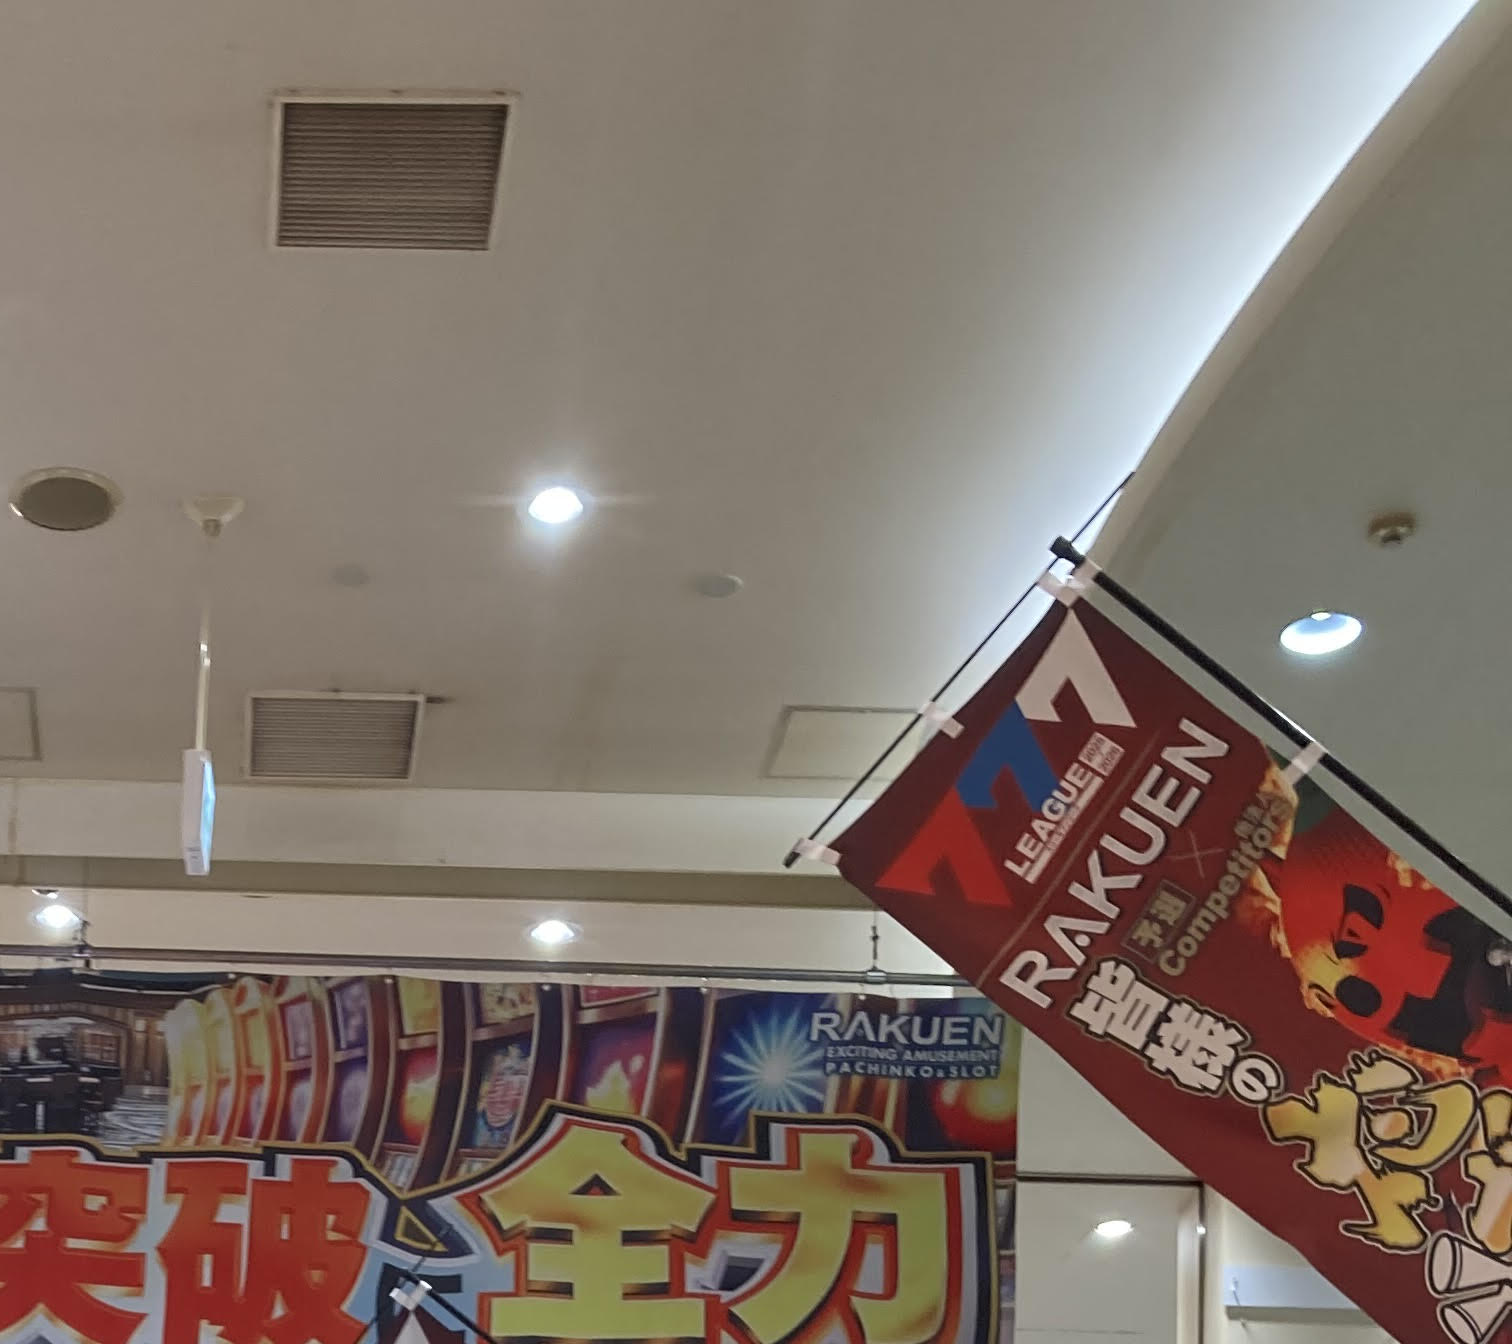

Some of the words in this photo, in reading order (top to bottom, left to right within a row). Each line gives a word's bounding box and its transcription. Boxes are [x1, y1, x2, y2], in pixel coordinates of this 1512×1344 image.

[1000, 714, 1233, 1010] RAKUEN
[1004, 762, 1090, 876] LEAGUE
[1157, 793, 1295, 978] Competitors
[808, 1010, 1004, 1046] RAKUEN
[826, 1046, 898, 1061] EXCITING
[901, 1049, 999, 1063] AMUSEMENT
